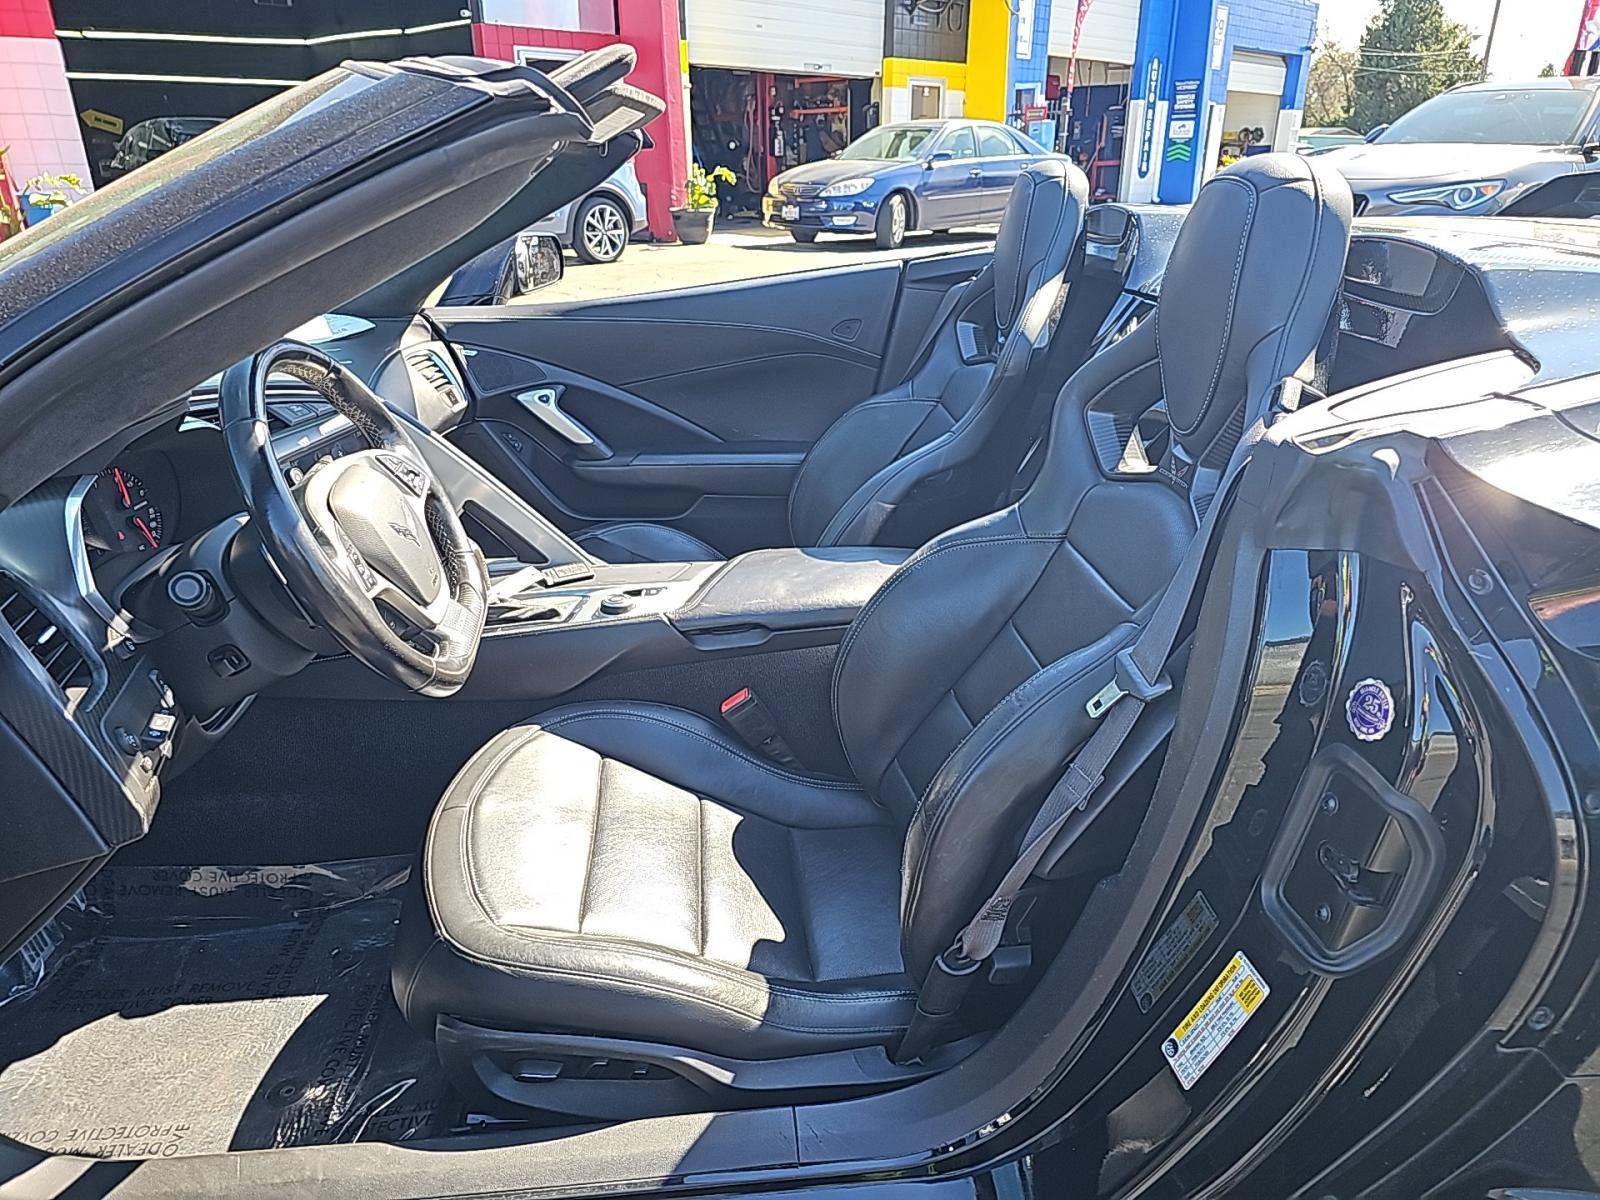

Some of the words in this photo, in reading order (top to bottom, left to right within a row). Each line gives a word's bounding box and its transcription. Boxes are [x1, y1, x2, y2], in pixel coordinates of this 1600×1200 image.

[1149, 57, 1159, 103] AUTO
[1363, 695, 1381, 714] 25
[64, 1123, 174, 1142] PROTECTIVE
